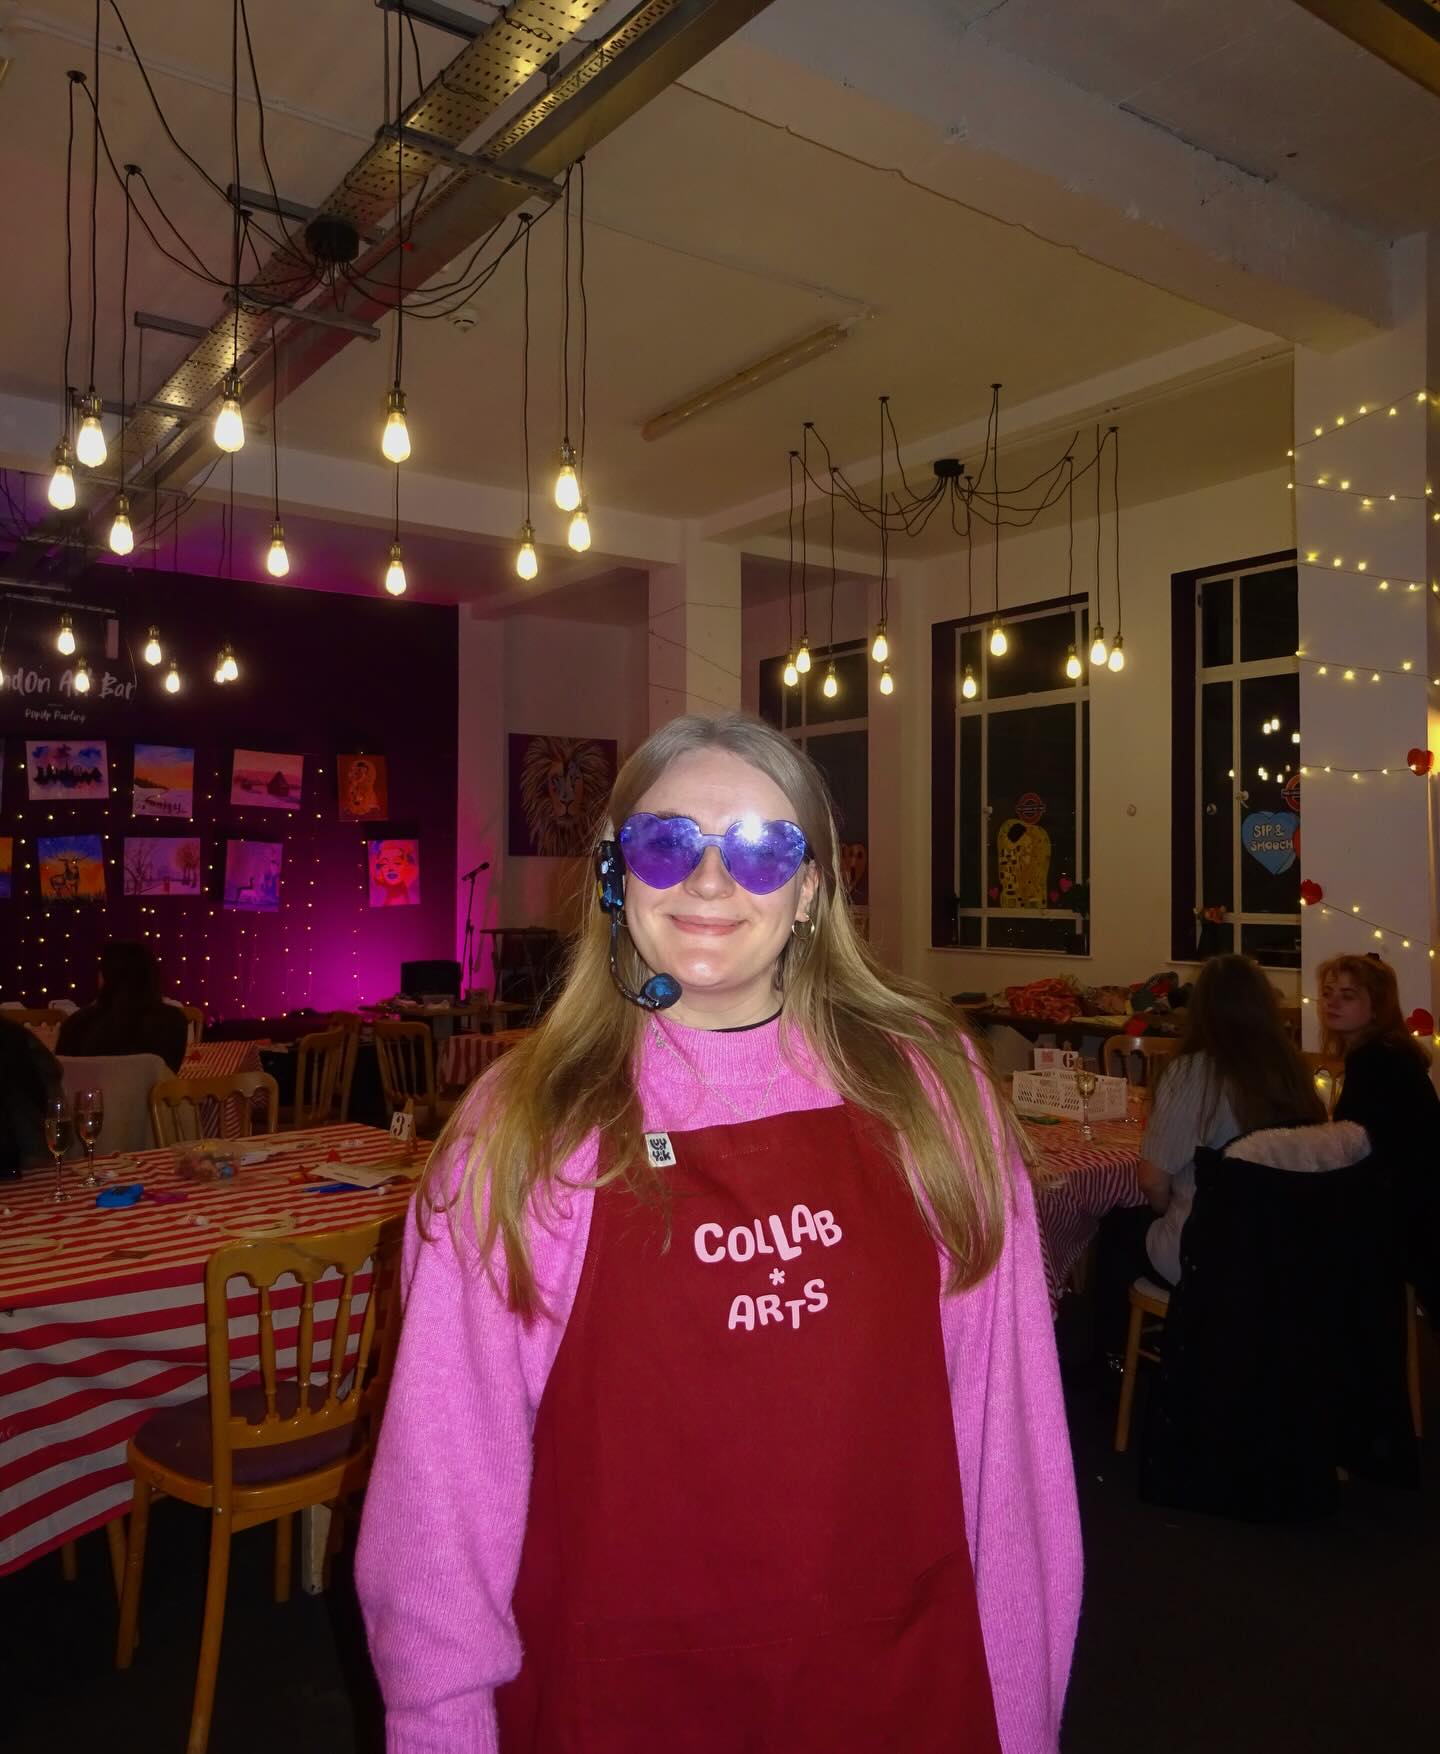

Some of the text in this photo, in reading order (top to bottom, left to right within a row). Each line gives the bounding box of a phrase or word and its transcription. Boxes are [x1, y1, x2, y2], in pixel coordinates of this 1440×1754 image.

[100, 671, 135, 699] Bar
[1254, 824, 1284, 838] SIP &
[1250, 839, 1293, 852] SMOOCH
[694, 1204, 843, 1263] COLLAB
[728, 1278, 829, 1331] ARTS
